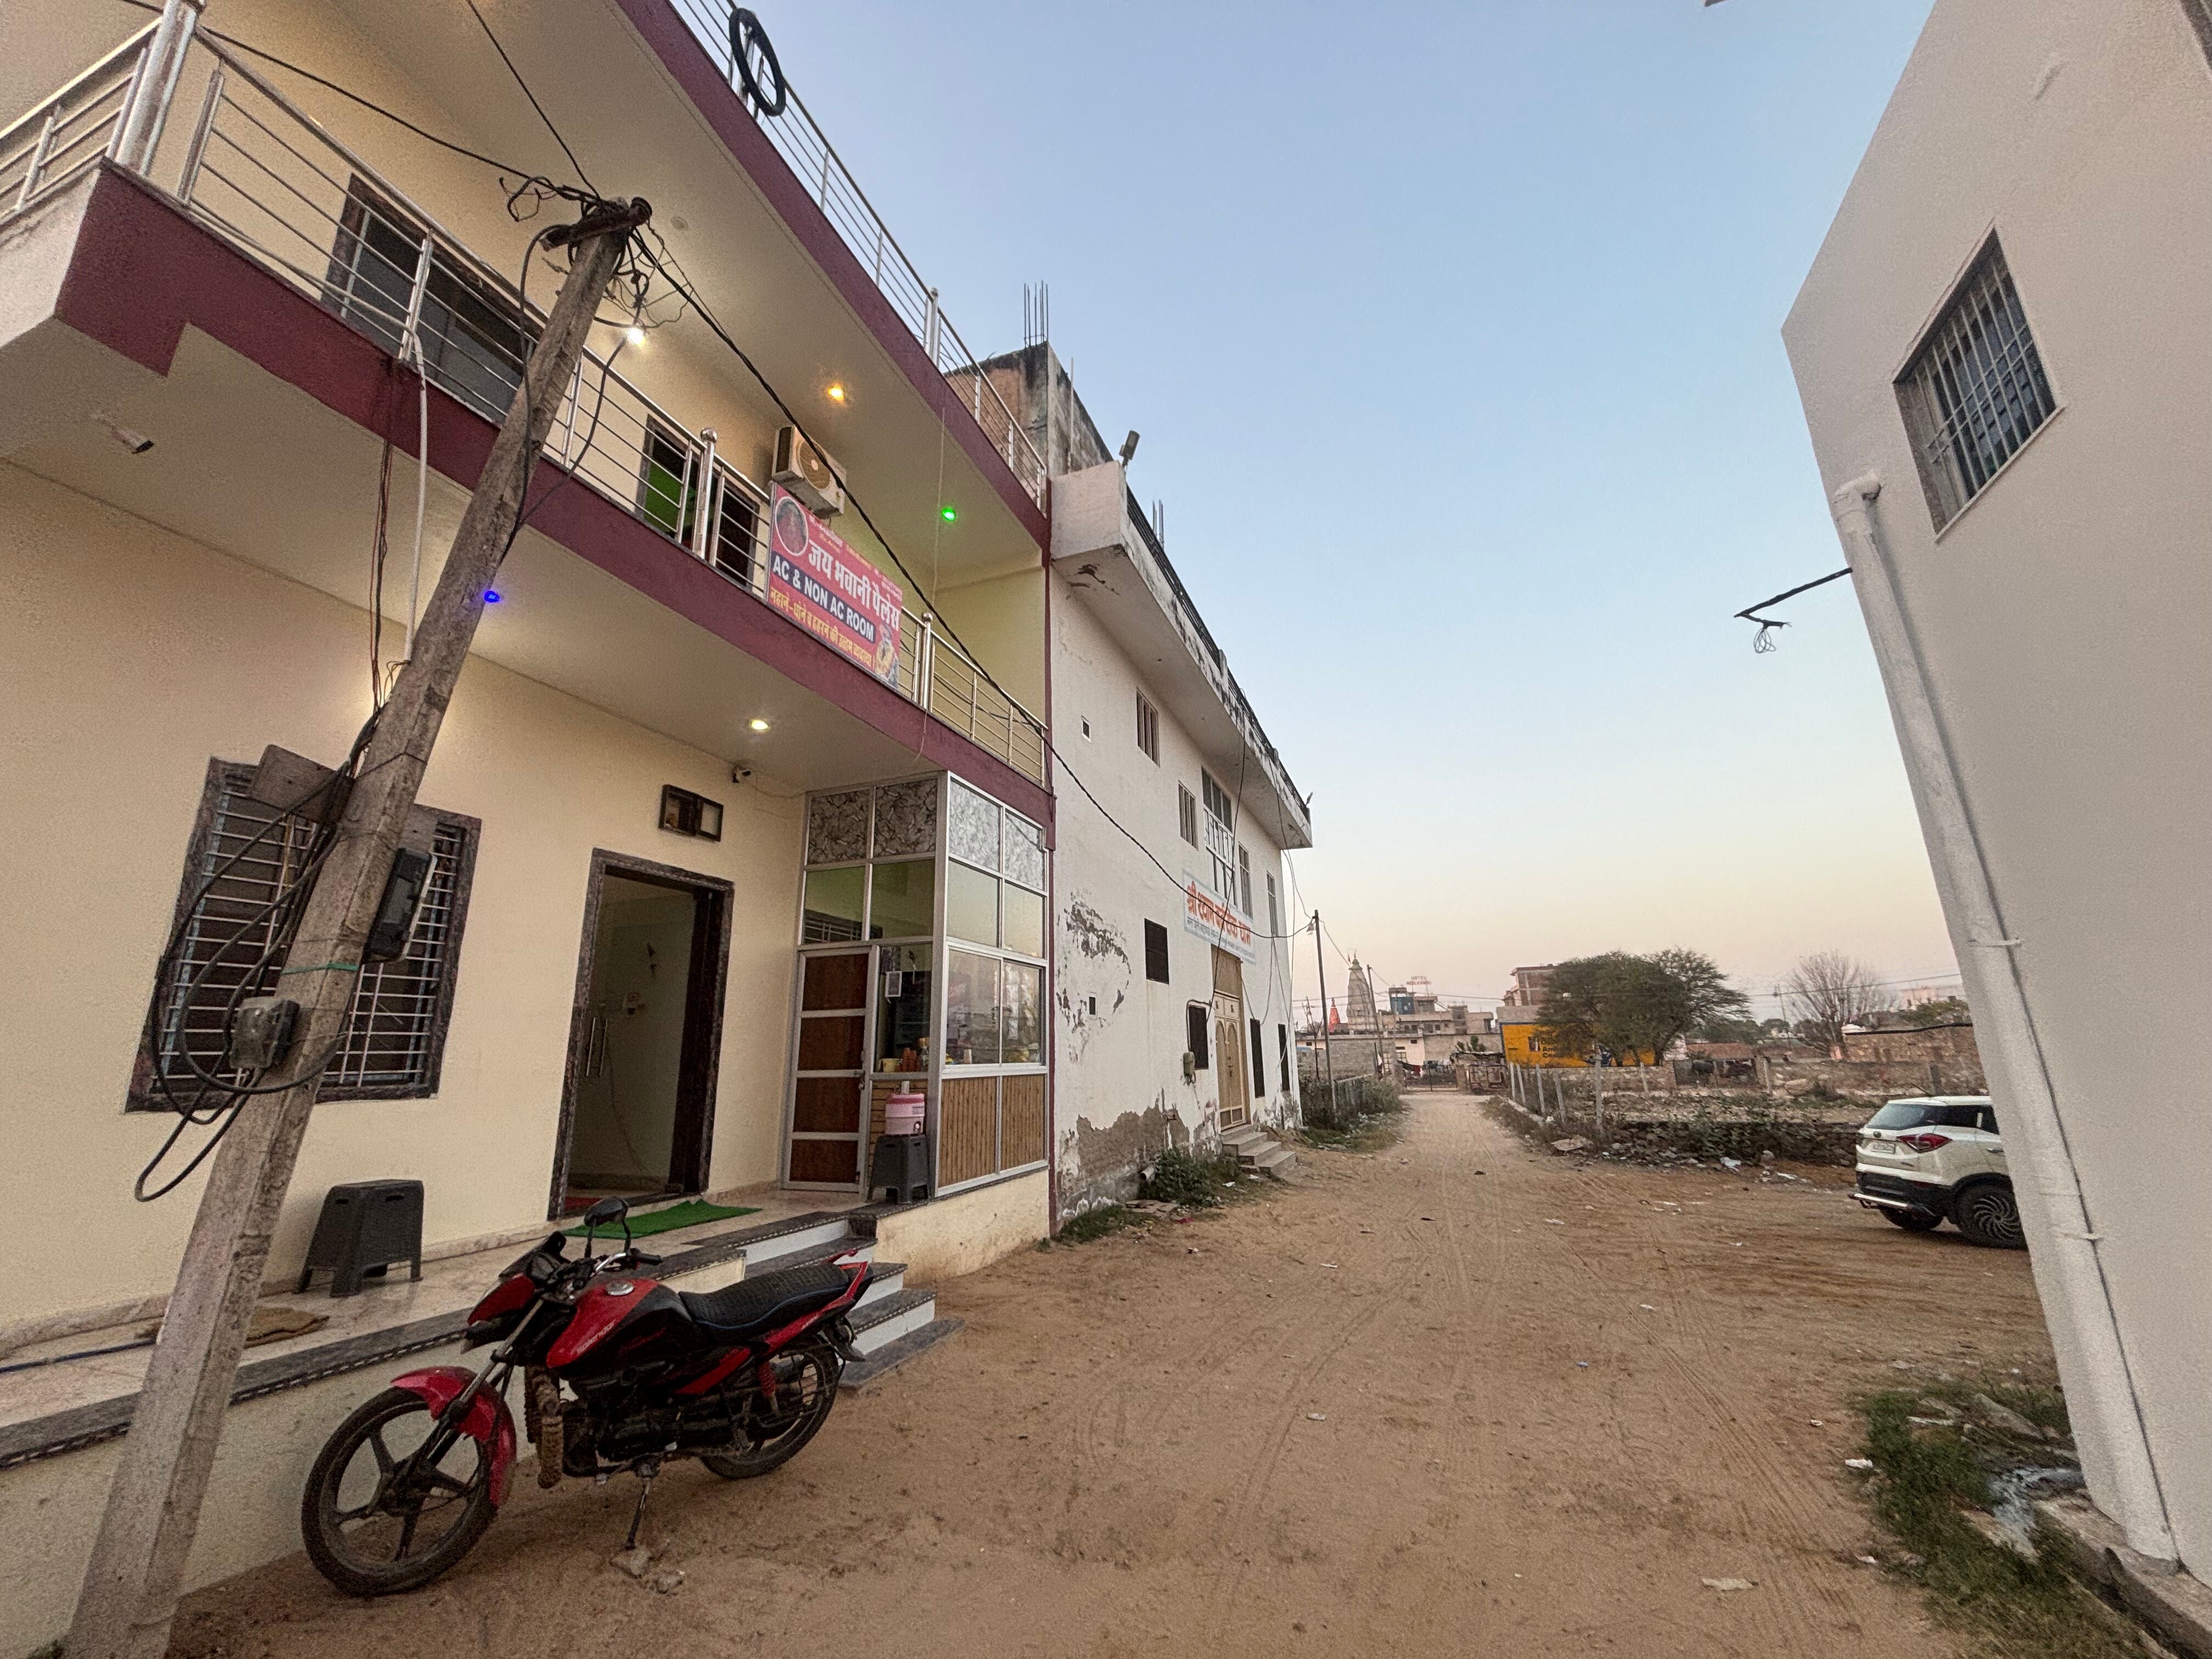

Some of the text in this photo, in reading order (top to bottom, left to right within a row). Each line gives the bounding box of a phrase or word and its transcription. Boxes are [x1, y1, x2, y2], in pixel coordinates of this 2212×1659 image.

[773, 555, 875, 642] AC & NON AC ROOM
[809, 539, 833, 579] जय
[835, 560, 871, 610] भवानी
[1187, 881, 1197, 917] श्री
